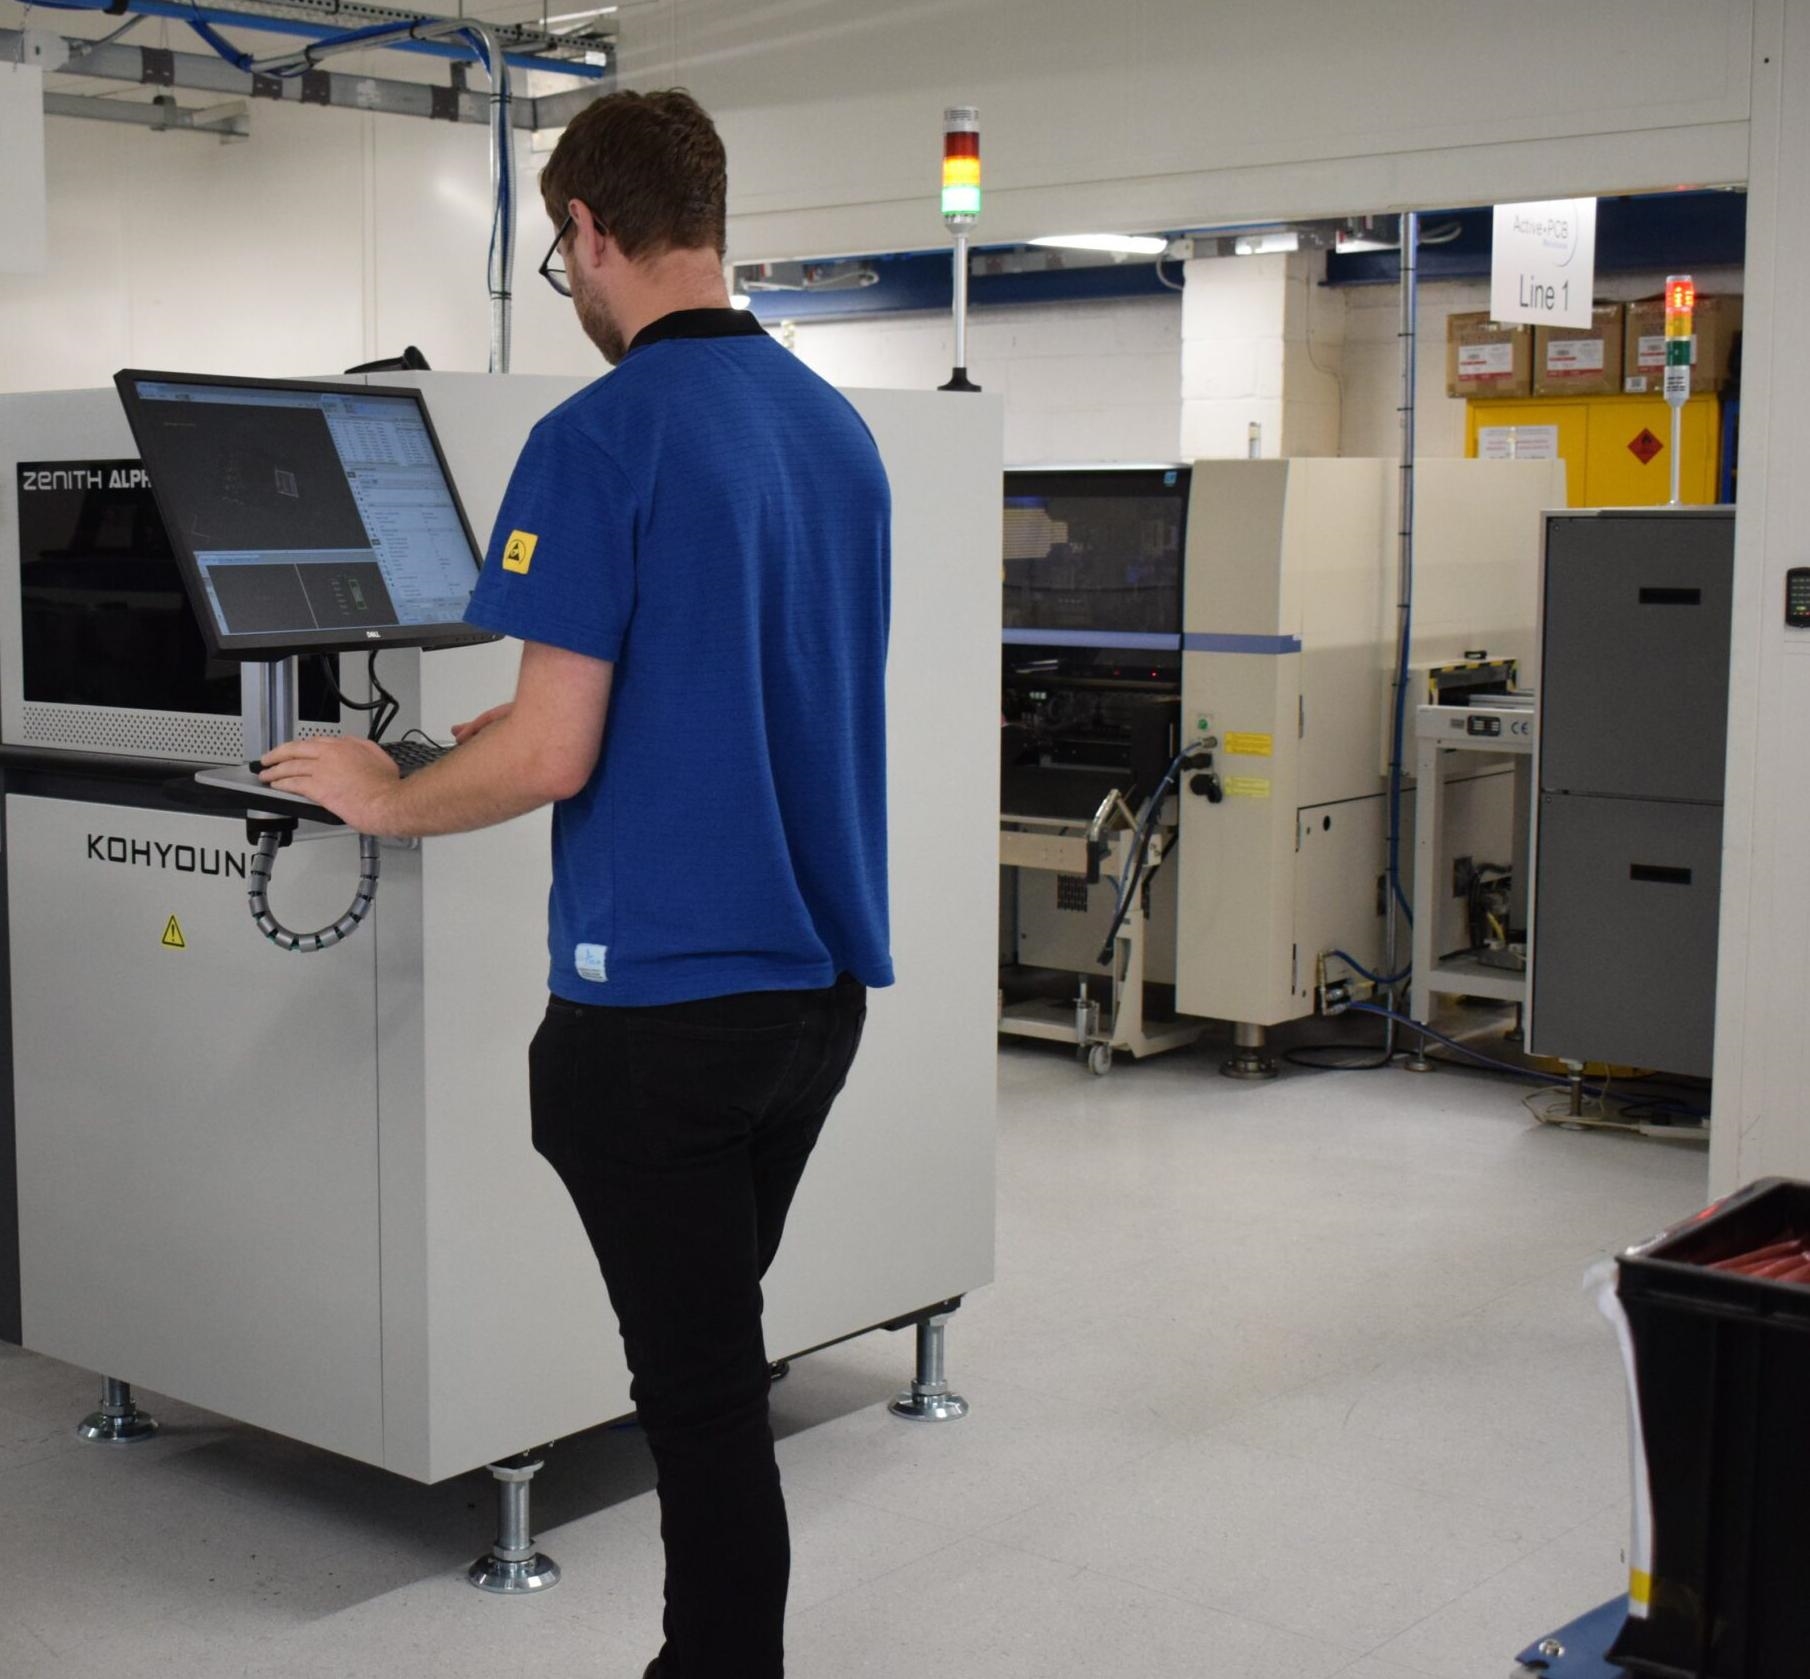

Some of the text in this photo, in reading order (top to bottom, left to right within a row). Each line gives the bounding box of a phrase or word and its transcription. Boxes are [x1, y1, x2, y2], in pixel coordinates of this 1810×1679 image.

[1519, 273, 1569, 311] Line 1
[366, 631, 381, 639] DELL
[1511, 722, 1529, 735] CE
[87, 833, 271, 880] KOHYOUN
